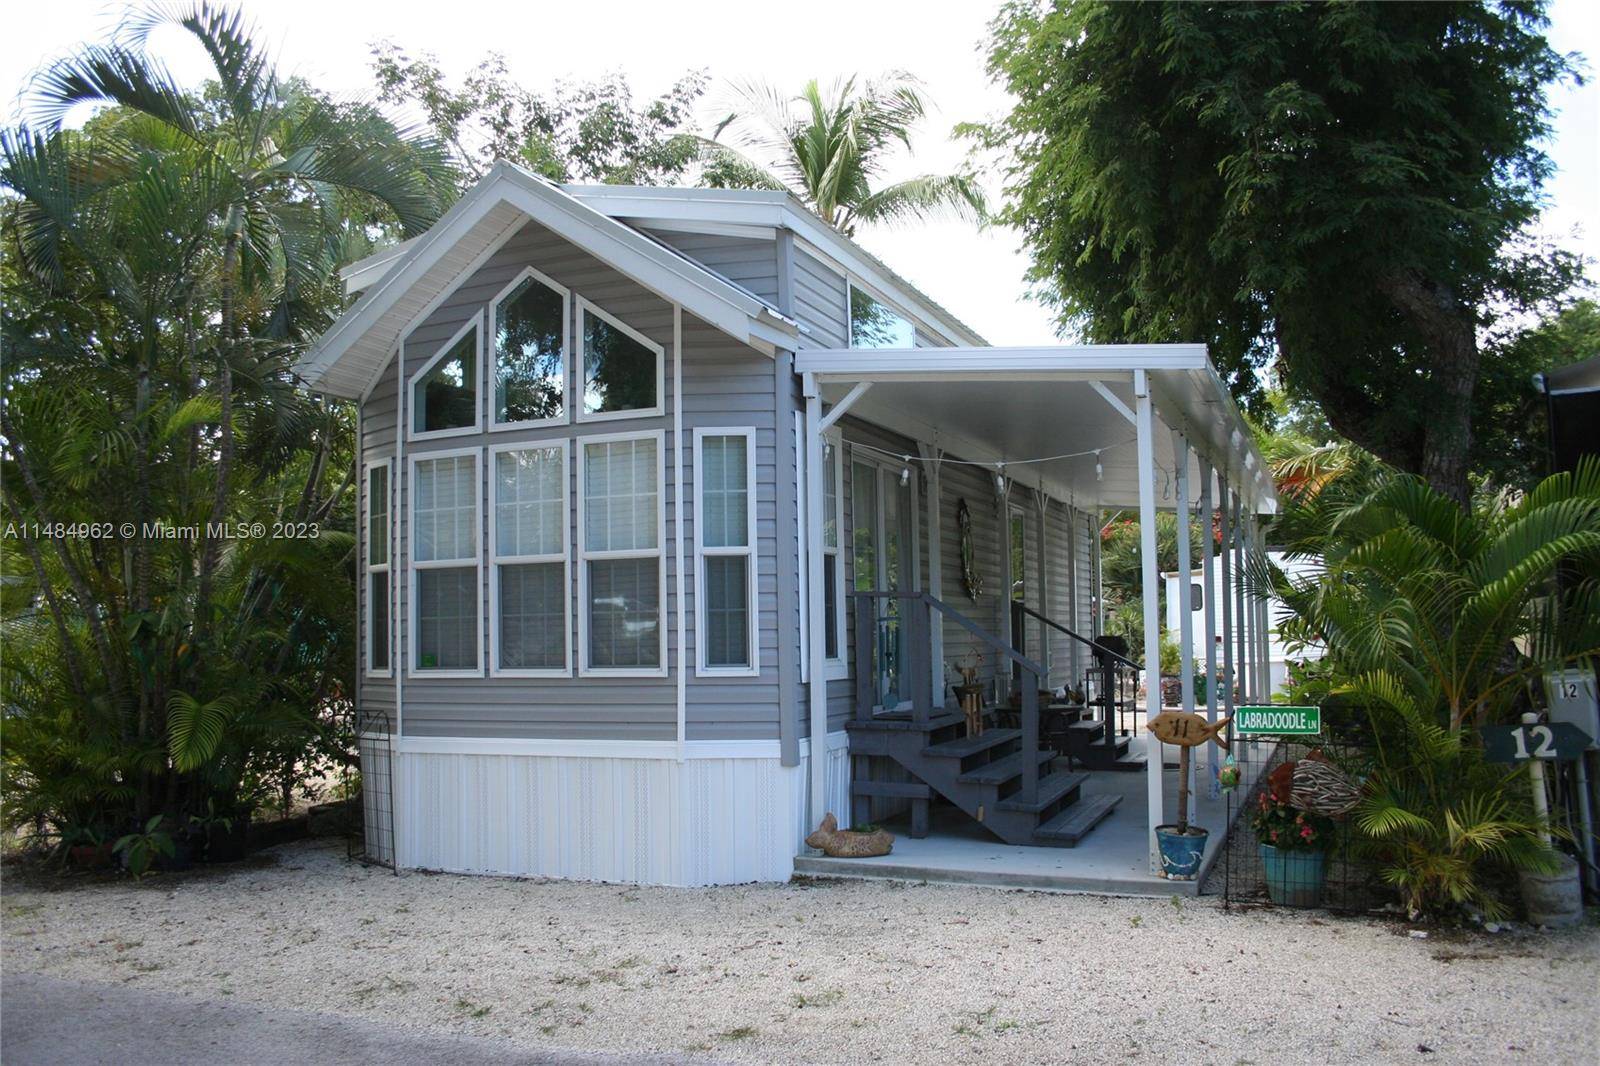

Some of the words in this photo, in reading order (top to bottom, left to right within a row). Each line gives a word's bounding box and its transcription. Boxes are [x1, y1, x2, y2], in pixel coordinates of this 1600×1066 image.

[1239, 712, 1306, 729] LABRADOODLE
[1308, 720, 1317, 729] LN
[1511, 725, 1557, 758] 12
